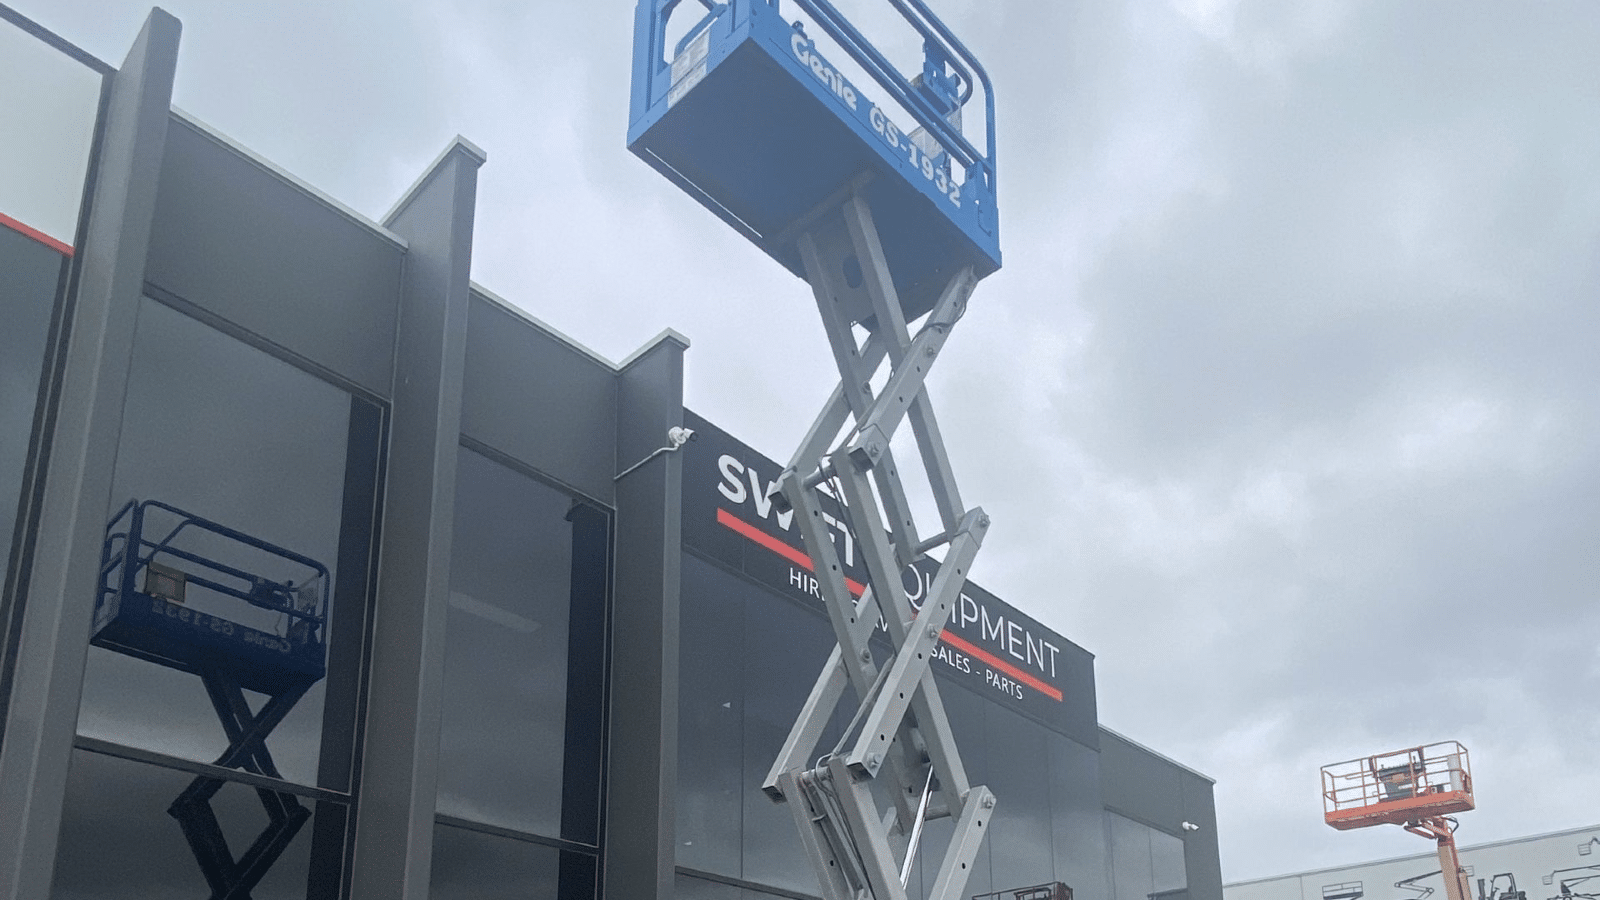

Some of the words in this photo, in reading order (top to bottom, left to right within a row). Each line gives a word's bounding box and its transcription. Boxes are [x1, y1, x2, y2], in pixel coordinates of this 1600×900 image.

[789, 32, 857, 111] Genie
[868, 106, 962, 208] GS-1932
[717, 454, 856, 567] SWT
[789, 567, 826, 602] HIR
[930, 646, 971, 675] SALES
[985, 669, 1023, 700] PARTS
[903, 563, 1060, 679] QIPMENT
